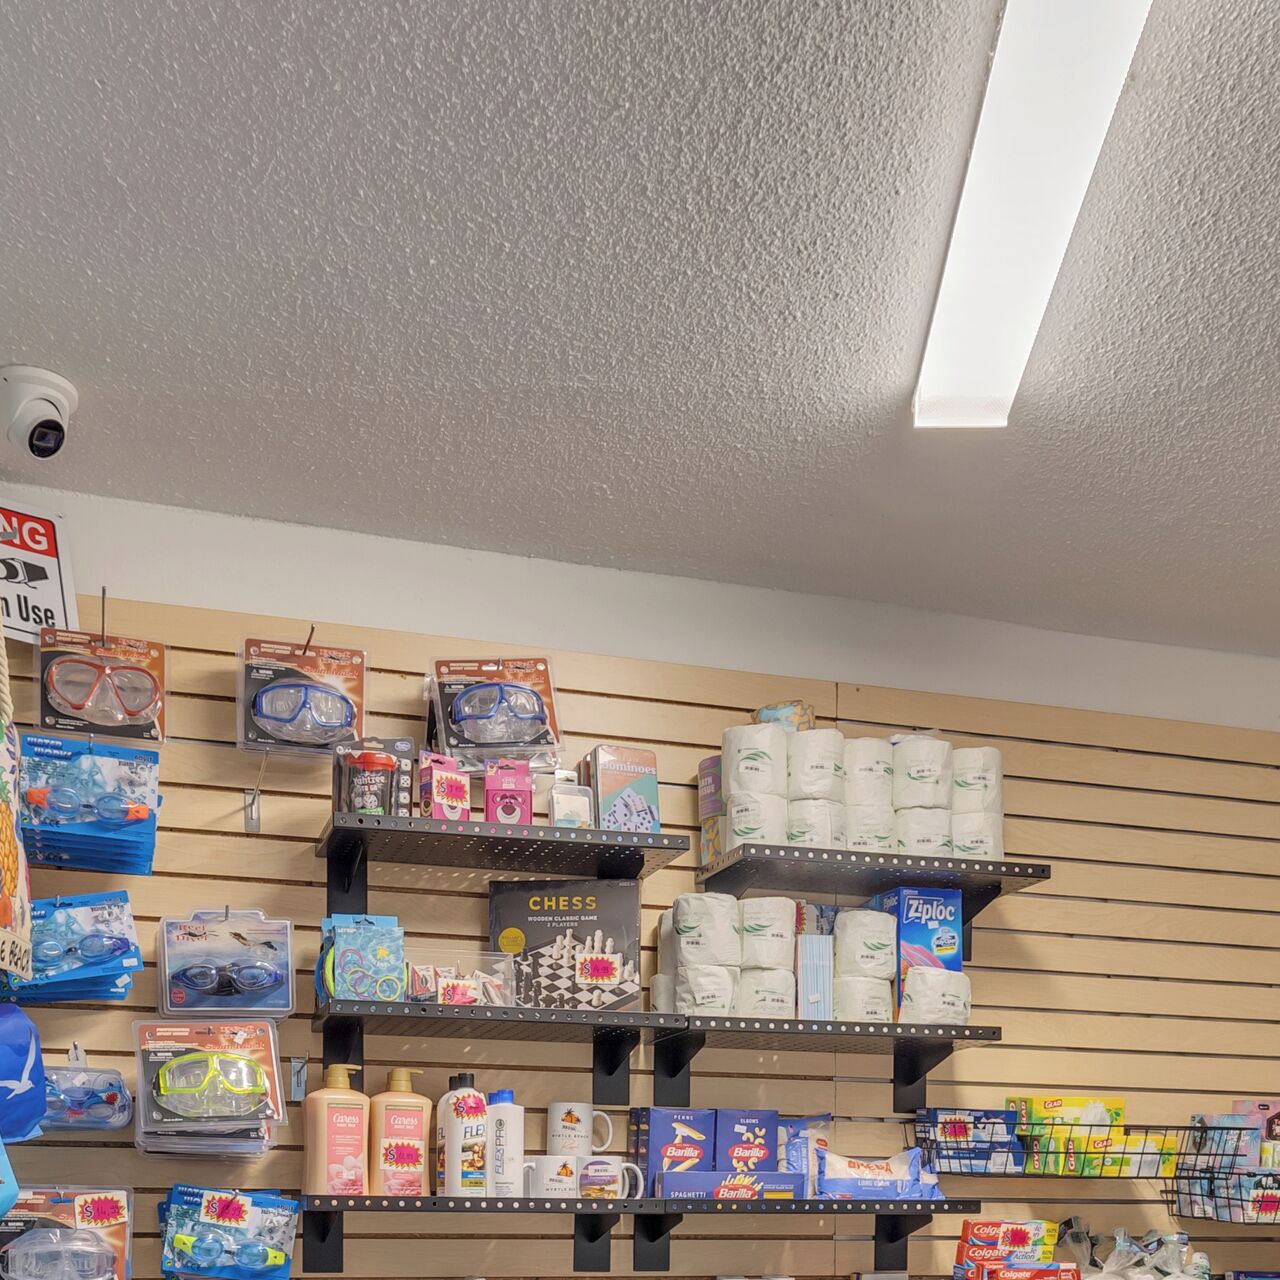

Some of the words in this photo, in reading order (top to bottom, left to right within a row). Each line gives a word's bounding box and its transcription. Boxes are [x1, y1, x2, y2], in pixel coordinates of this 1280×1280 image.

[16, 594, 56, 628] Use
[528, 896, 598, 911] CHESS
[908, 899, 956, 923] Ziploc
[1045, 1100, 1062, 1108] GLAD
[332, 1113, 360, 1124] Caress
[390, 1115, 418, 1126] Caress
[1094, 1139, 1112, 1148] GLAD
[667, 1146, 700, 1158] Barilla
[733, 1147, 765, 1159] Barilla
[670, 1191, 706, 1199] SPAGHETTI
[717, 1187, 753, 1200] Barilla
[974, 1224, 1001, 1235] Colga
[969, 1247, 1009, 1257] Colgate
[999, 1270, 1032, 1279] Colgate
